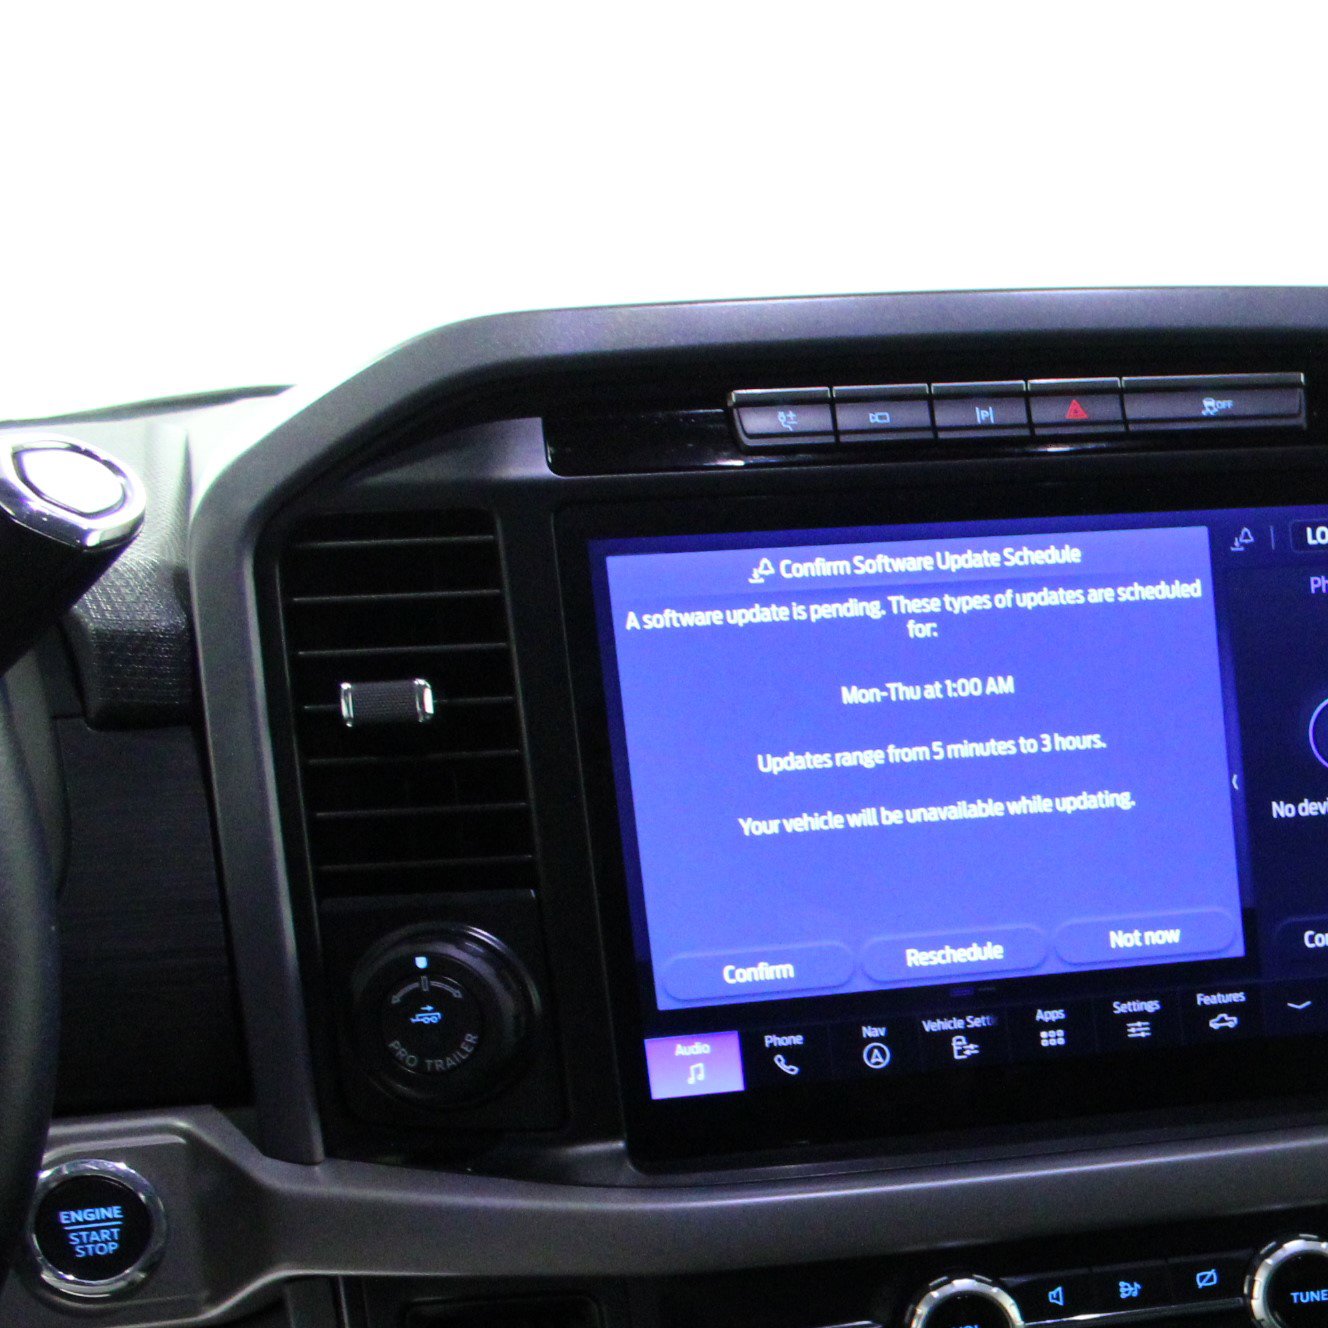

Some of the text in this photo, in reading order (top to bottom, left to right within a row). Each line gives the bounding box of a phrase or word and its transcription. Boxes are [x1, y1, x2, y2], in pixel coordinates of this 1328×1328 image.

[1216, 400, 1233, 410] OFF
[780, 544, 1082, 579] Confirm Software Update Schedule
[625, 578, 1202, 630] A software update is pending. These types of updates are scheduled
[907, 619, 938, 638] for:
[841, 675, 1016, 705] Mon-Thu at 1:00 AM
[757, 732, 1107, 775] Updates range from 5 minutes to 3 hours.
[738, 790, 1136, 837] Your vehicle will be unavailable while updating.
[1271, 800, 1296, 818] No
[1109, 928, 1182, 949] Not now
[905, 941, 1004, 967] Reschedule
[723, 961, 795, 984] Confirm
[1112, 999, 1160, 1014] Settings
[1196, 991, 1246, 1005] Features
[1035, 1008, 1066, 1023] Apps
[861, 1025, 886, 1039] Nav
[921, 1017, 965, 1033] Vehicle
[674, 1041, 711, 1056] Audio
[763, 1033, 804, 1048] Phone
[388, 1032, 480, 1072] PRO TRAILER
[59, 1206, 124, 1223] ENGINE
[68, 1228, 121, 1245] START
[75, 1242, 118, 1257] STOP
